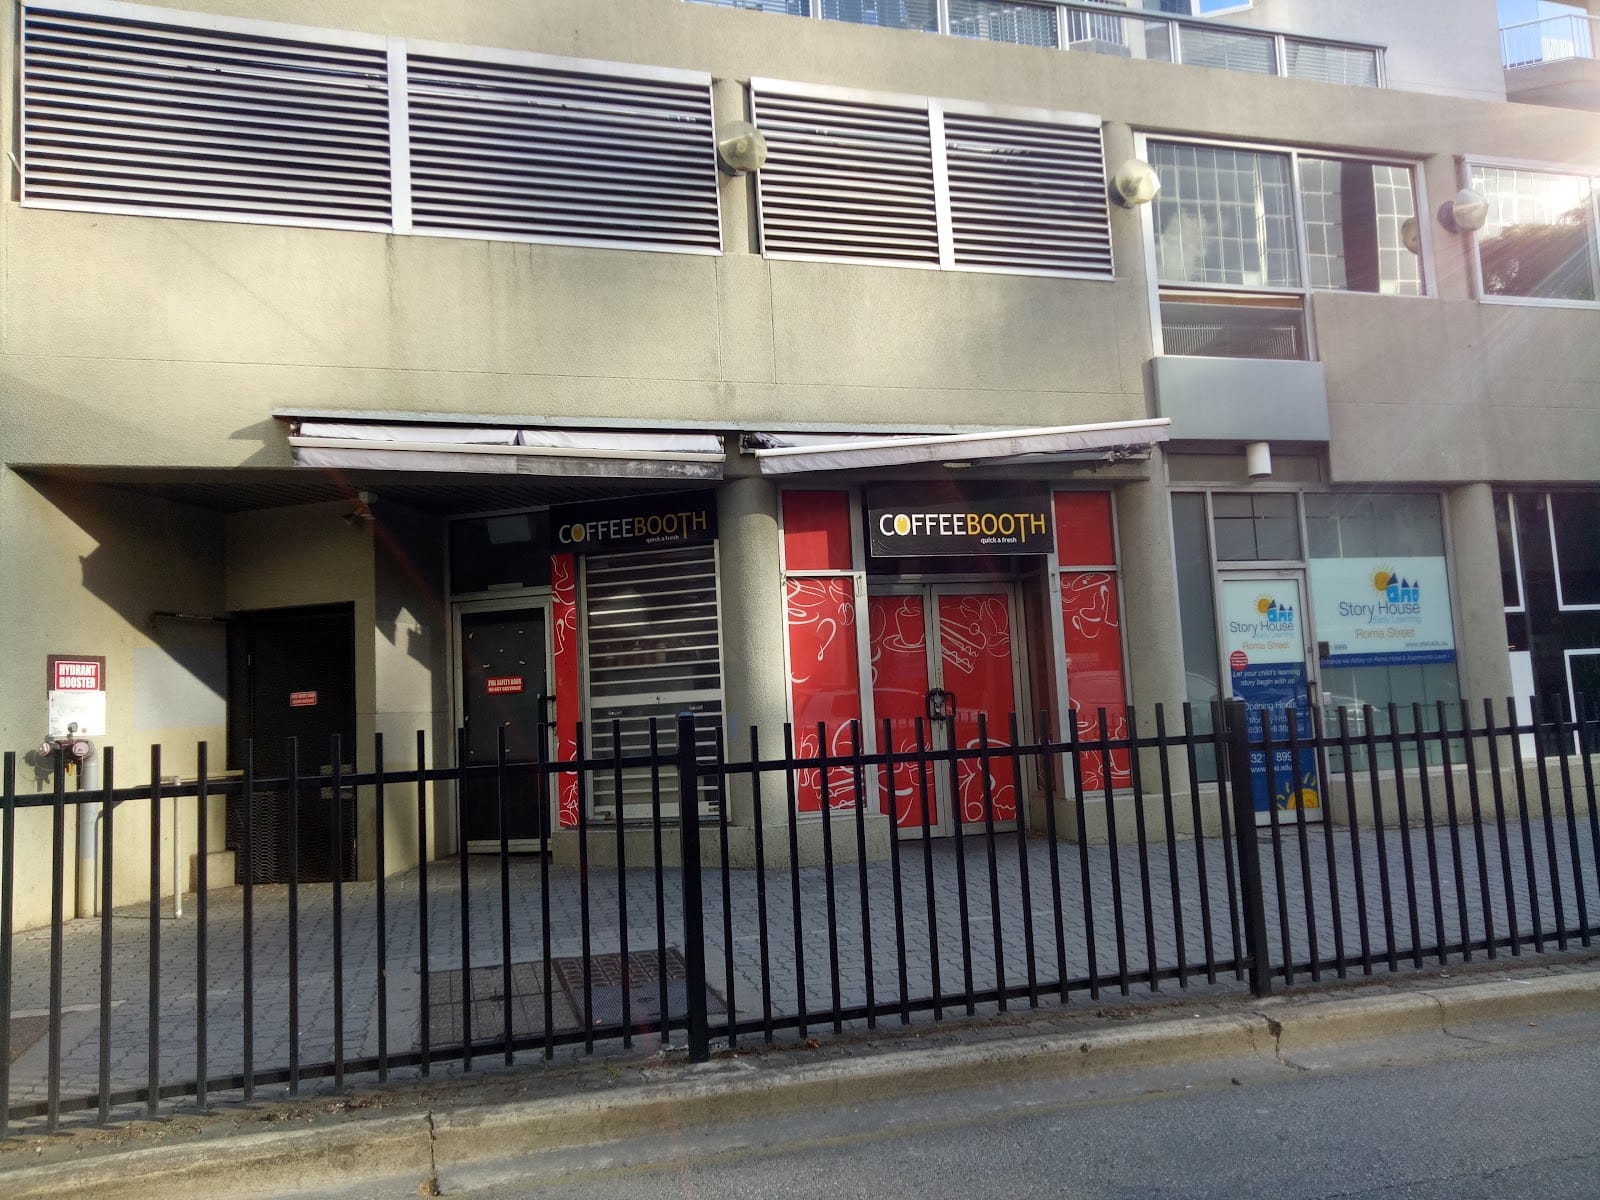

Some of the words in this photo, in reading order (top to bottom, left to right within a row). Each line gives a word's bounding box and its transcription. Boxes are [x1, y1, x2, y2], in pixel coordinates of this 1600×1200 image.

[558, 510, 707, 544] COFFEEBOOTH
[879, 513, 1046, 543] COFFEEBOOTH
[1340, 601, 1375, 624] Story
[1378, 600, 1421, 615] House
[1230, 621, 1258, 638] Story
[1260, 620, 1294, 632] House
[1355, 628, 1385, 639] Roma
[1385, 627, 1415, 638] Street
[1242, 641, 1265, 650] Roma
[1267, 640, 1290, 649] Street
[58, 663, 96, 676] HYDRANT
[1258, 669, 1277, 677] child's
[1277, 669, 1301, 677] learning
[58, 676, 96, 689] BOOSTER
[1257, 679, 1273, 687] begin
[1244, 702, 1274, 712] Opening
[1275, 701, 1297, 709] Hours
